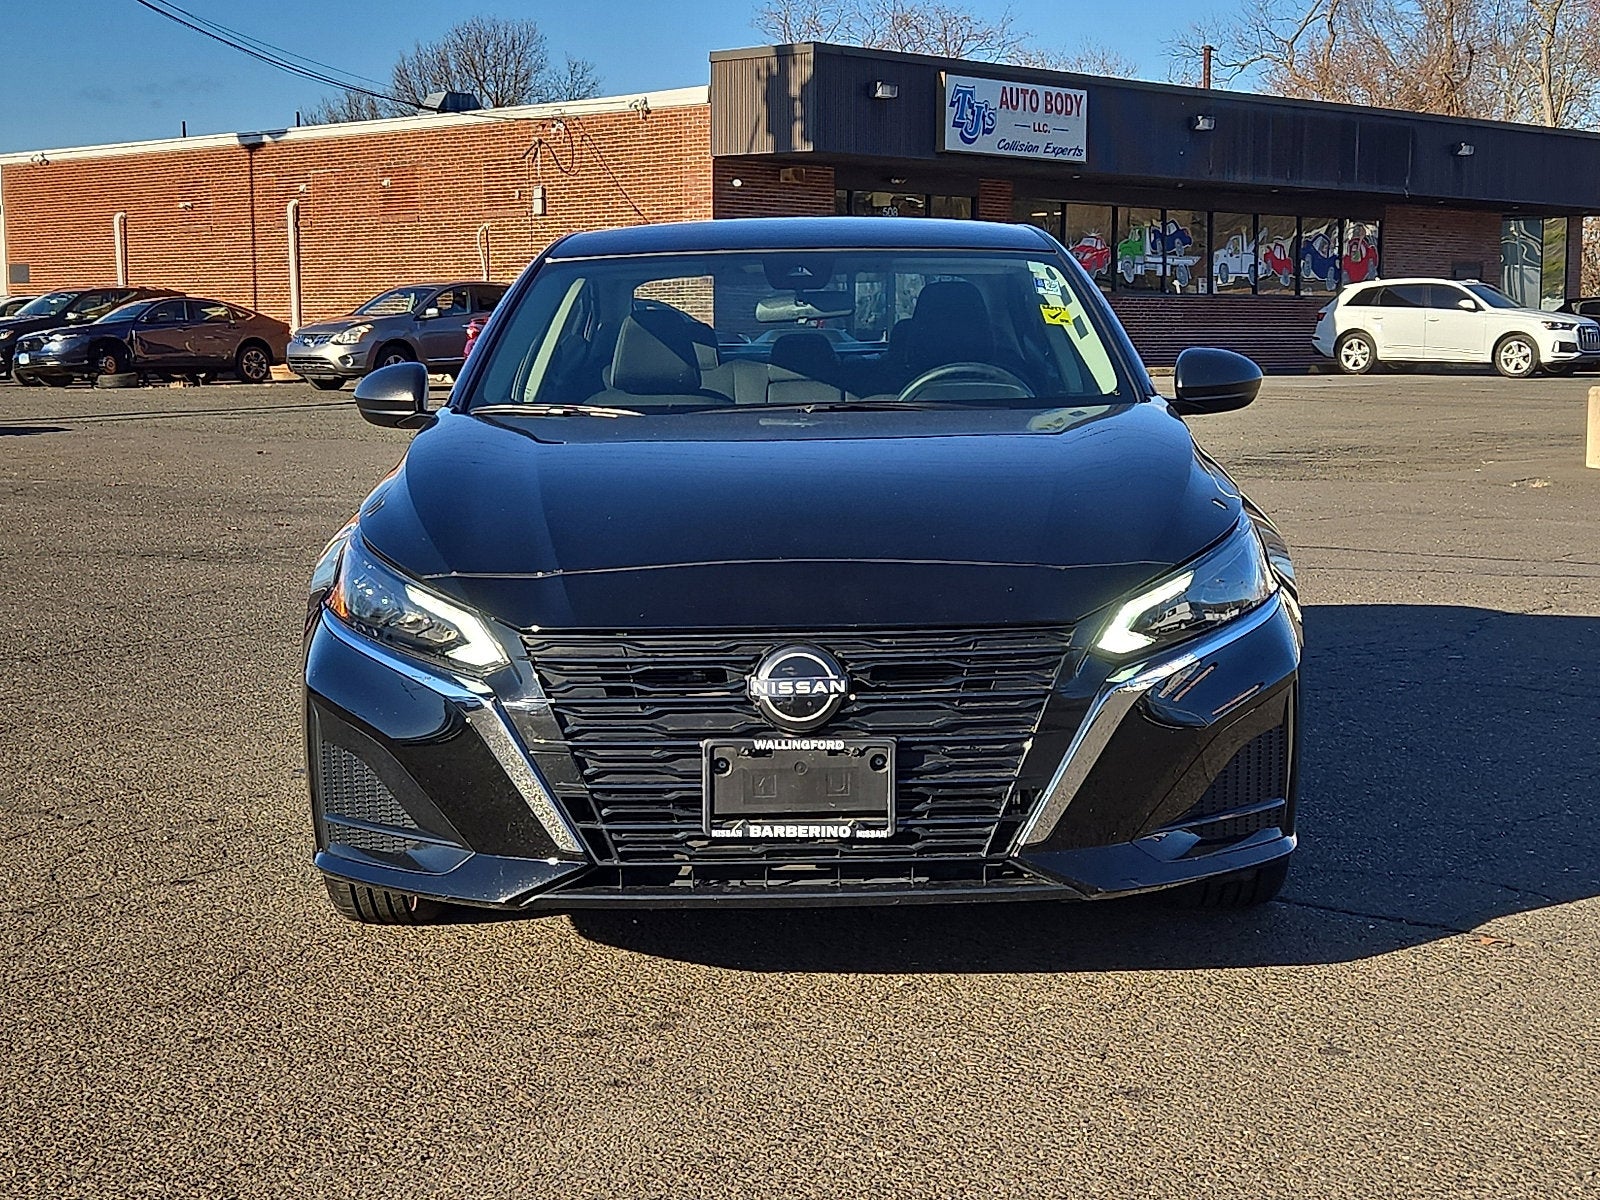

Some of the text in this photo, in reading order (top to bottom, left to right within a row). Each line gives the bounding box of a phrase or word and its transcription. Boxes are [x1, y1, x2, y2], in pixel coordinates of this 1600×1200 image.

[999, 86, 1084, 117] AUTO BODY
[997, 138, 1084, 157] Collision Experts
[752, 680, 846, 695] NISSAN
[753, 739, 845, 750] WALLINGFORD
[711, 829, 743, 837] NISSAN
[749, 825, 851, 838] BARBERINO
[856, 829, 888, 838] NISSAN
